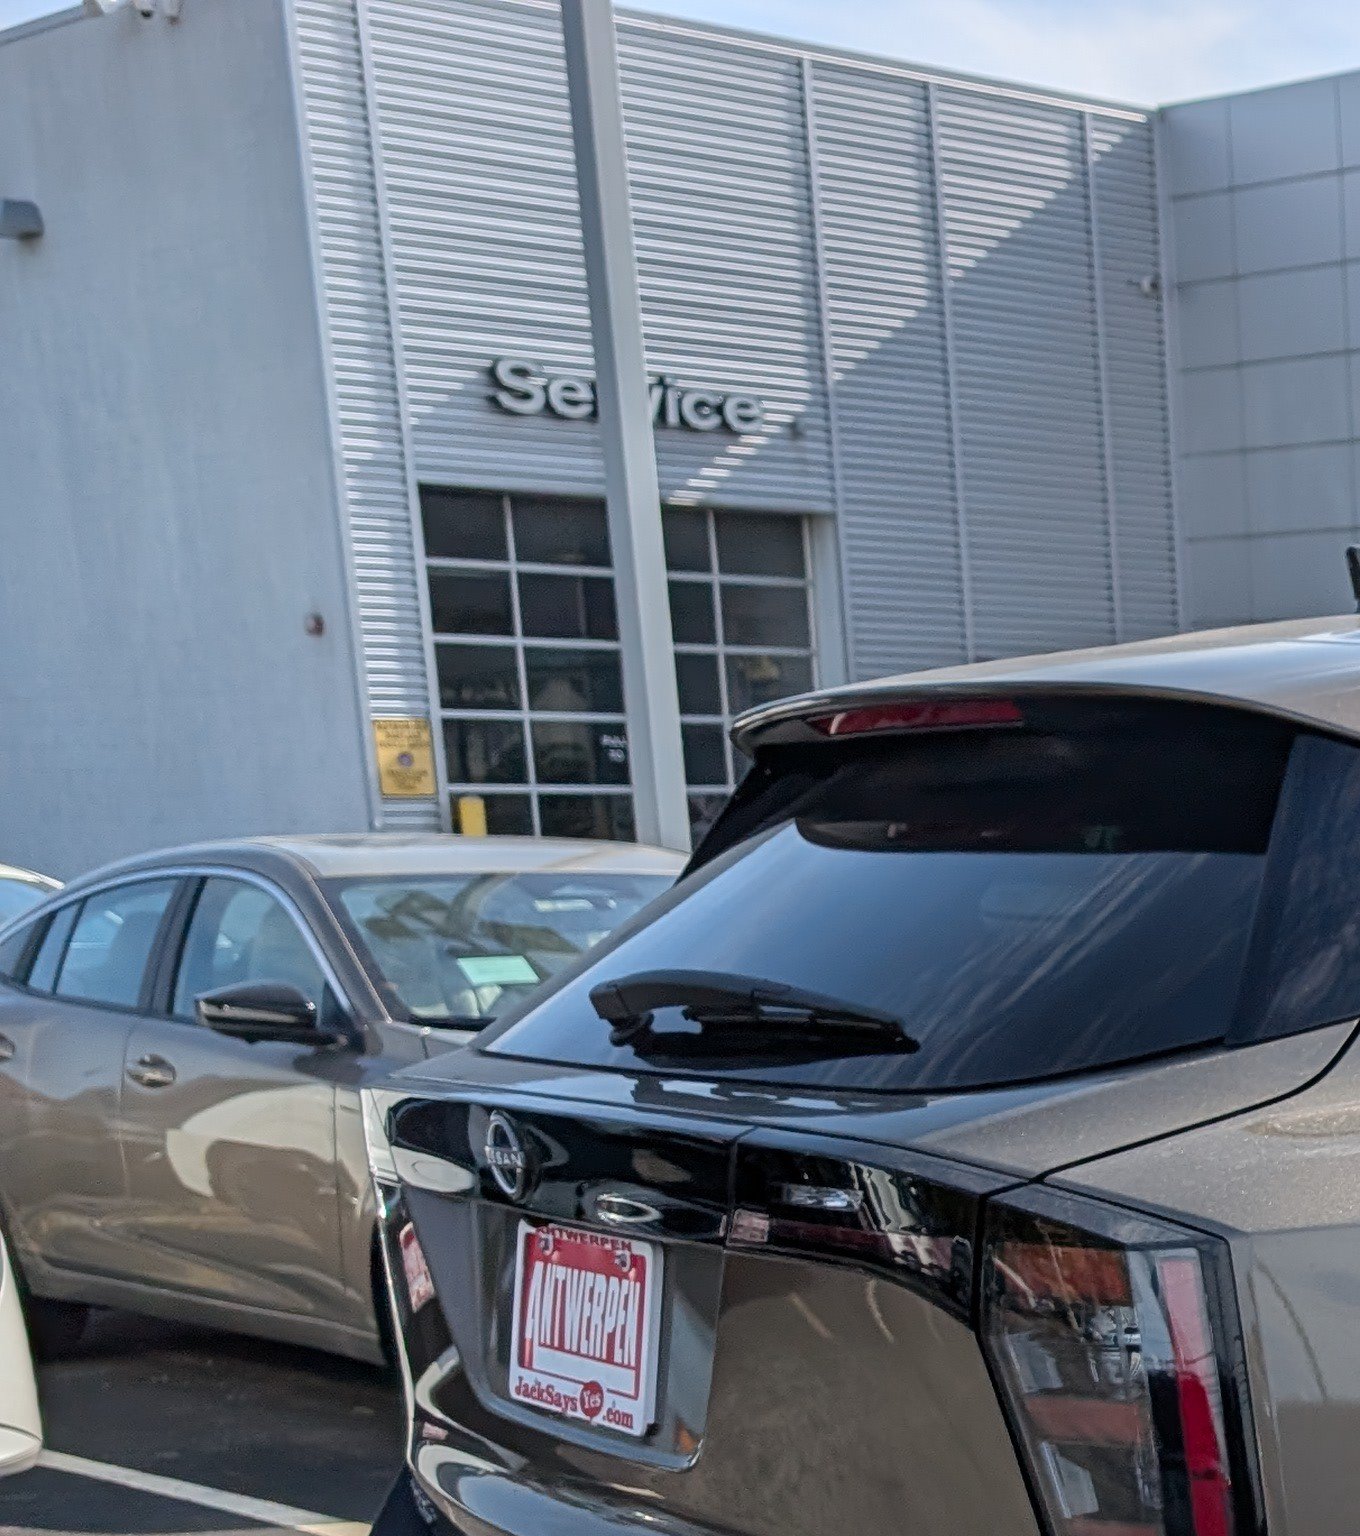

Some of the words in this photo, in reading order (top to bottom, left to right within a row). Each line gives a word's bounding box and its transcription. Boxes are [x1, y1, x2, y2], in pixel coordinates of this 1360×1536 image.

[494, 357, 764, 434] Sevice
[525, 1260, 641, 1368] ANTWERPEN
[515, 1375, 578, 1412] JackSays
